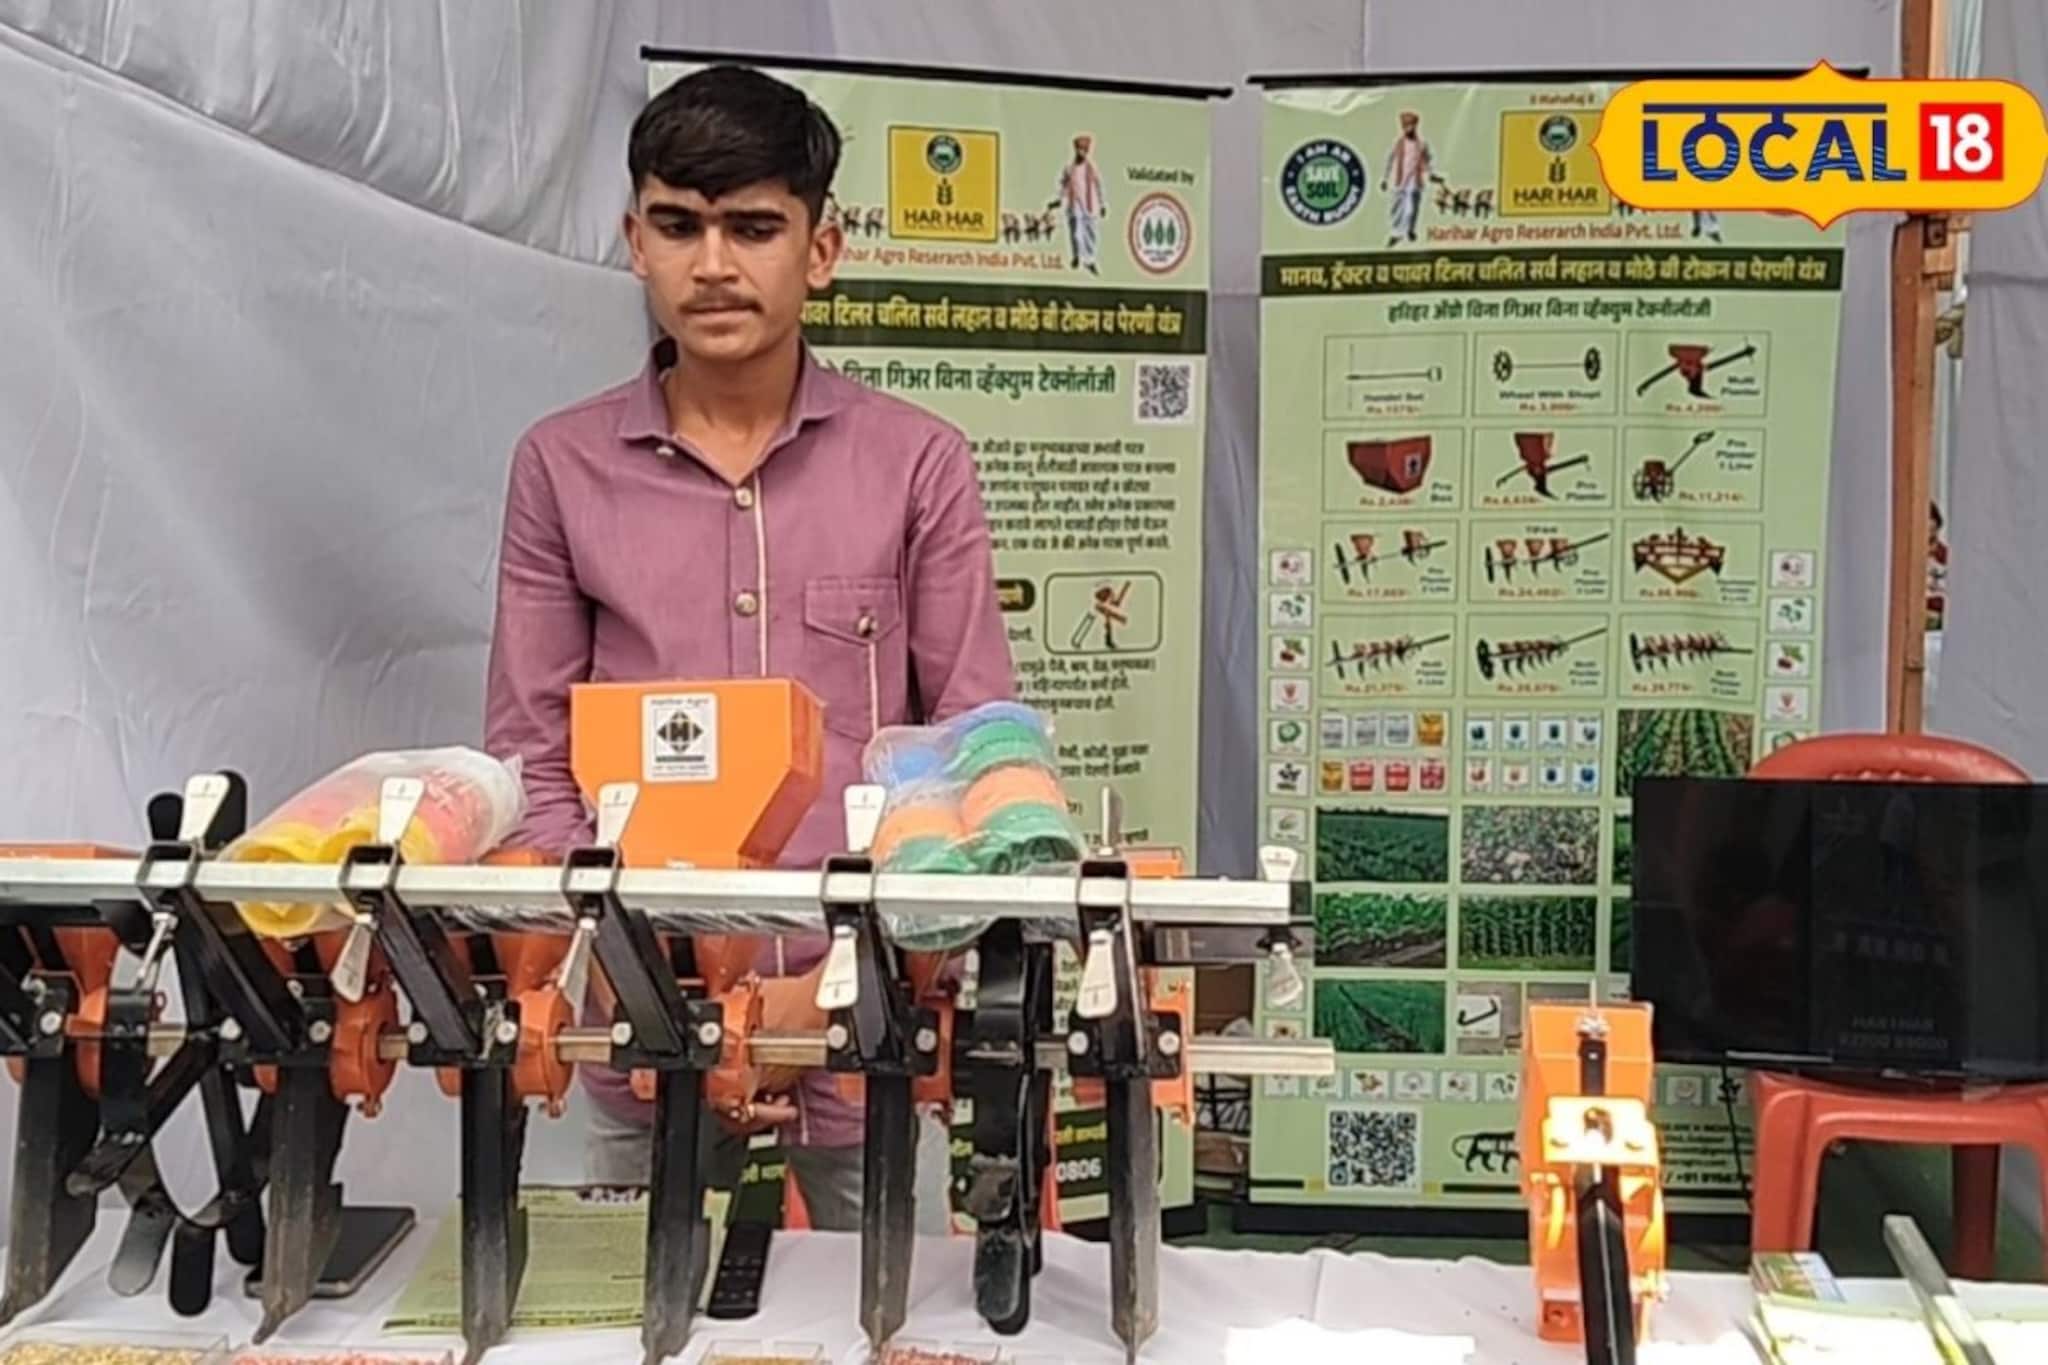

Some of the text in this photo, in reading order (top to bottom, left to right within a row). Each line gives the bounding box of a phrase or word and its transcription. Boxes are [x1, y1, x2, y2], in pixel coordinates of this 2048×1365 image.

[1127, 166, 1195, 187] Validated by
[1306, 181, 1340, 199] SOIL
[1513, 186, 1599, 204] HAR HAR
[904, 208, 985, 227] HAR HAR
[1428, 225, 1479, 242] Harihar
[1481, 225, 1514, 244] Agro
[1589, 223, 1623, 240] India
[874, 249, 906, 267] Agro
[977, 251, 1010, 268] India
